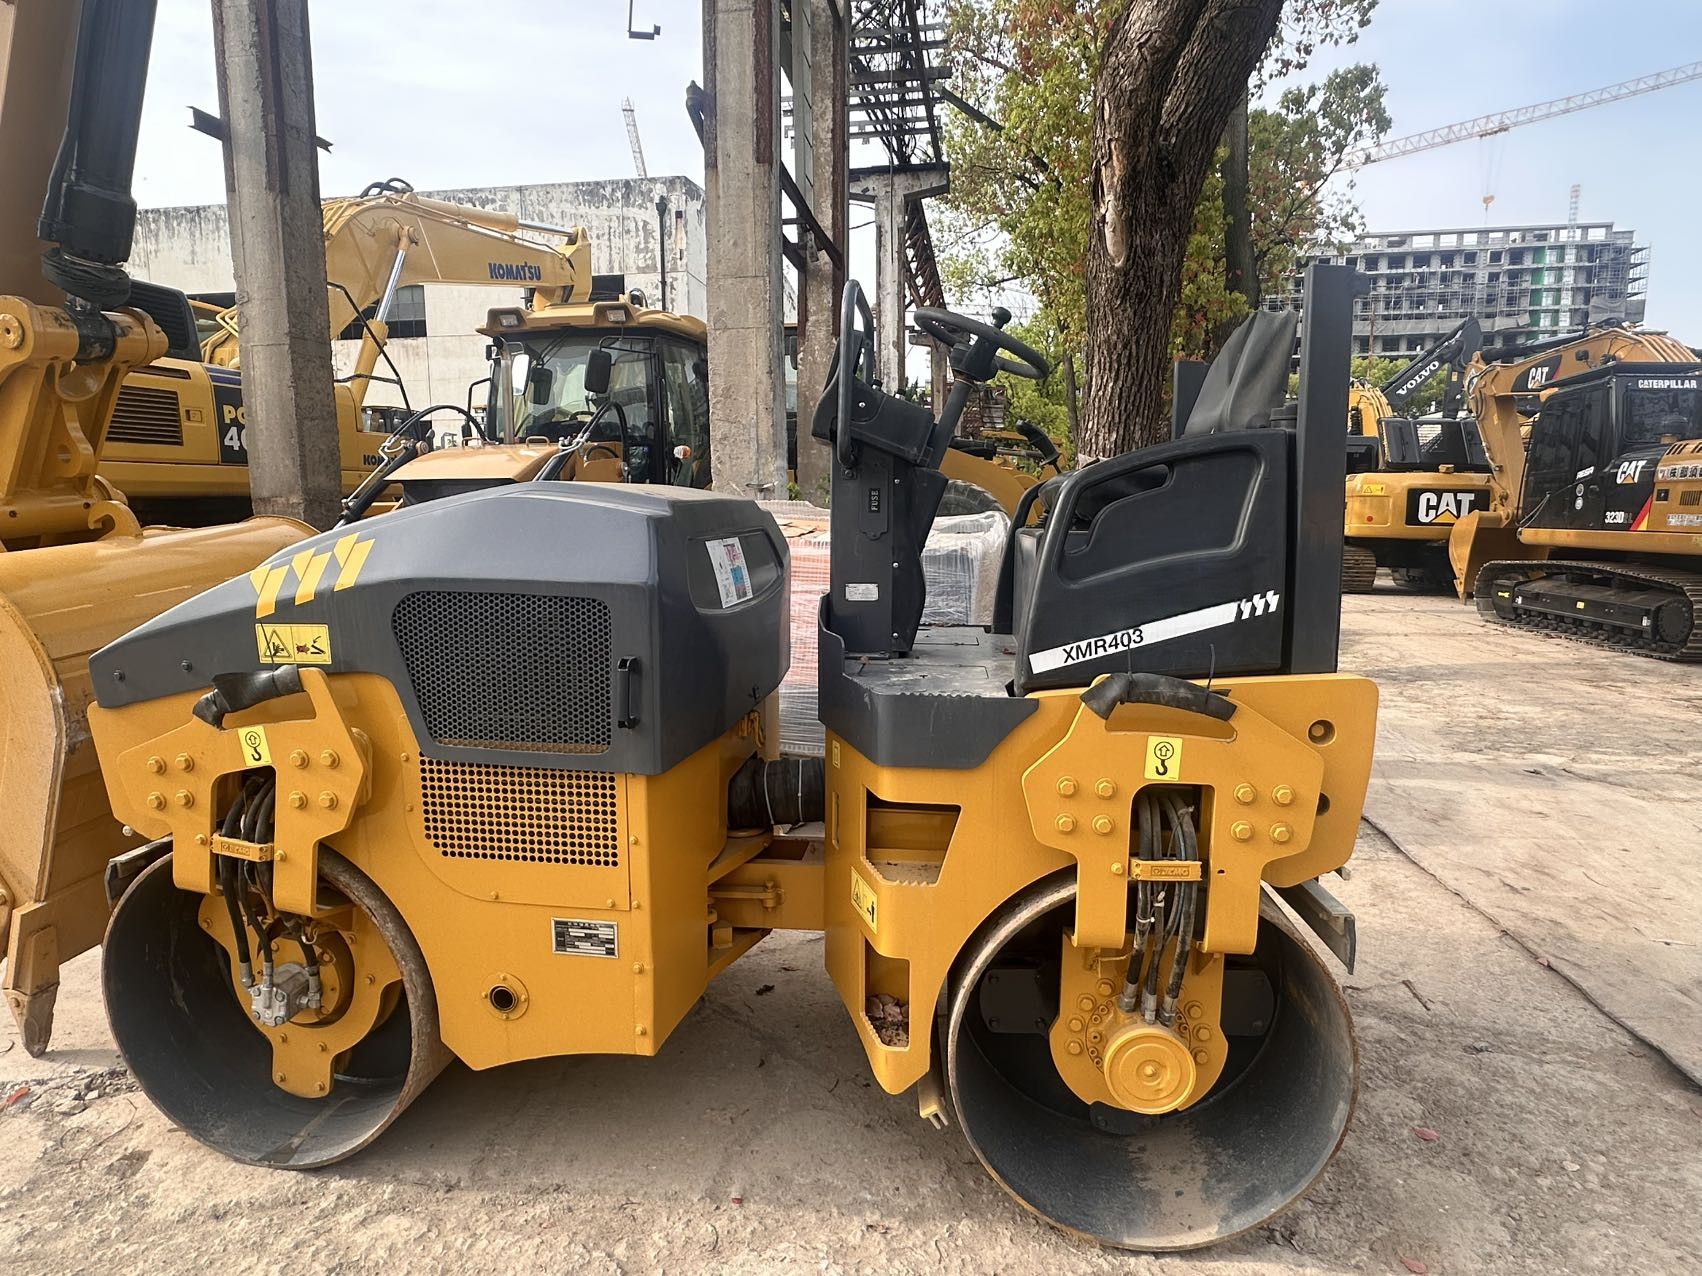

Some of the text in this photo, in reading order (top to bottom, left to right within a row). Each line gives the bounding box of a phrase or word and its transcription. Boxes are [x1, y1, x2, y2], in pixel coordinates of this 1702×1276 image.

[488, 261, 541, 281] KOMATSU
[1396, 361, 1439, 395] VOLVO
[1528, 367, 1549, 389] CAT
[1638, 379, 1697, 389] CATERPILLAR
[1616, 460, 1647, 484] CAT
[871, 490, 879, 511] FUSE
[1418, 492, 1475, 523] CAT
[1062, 628, 1144, 664] XMR403
